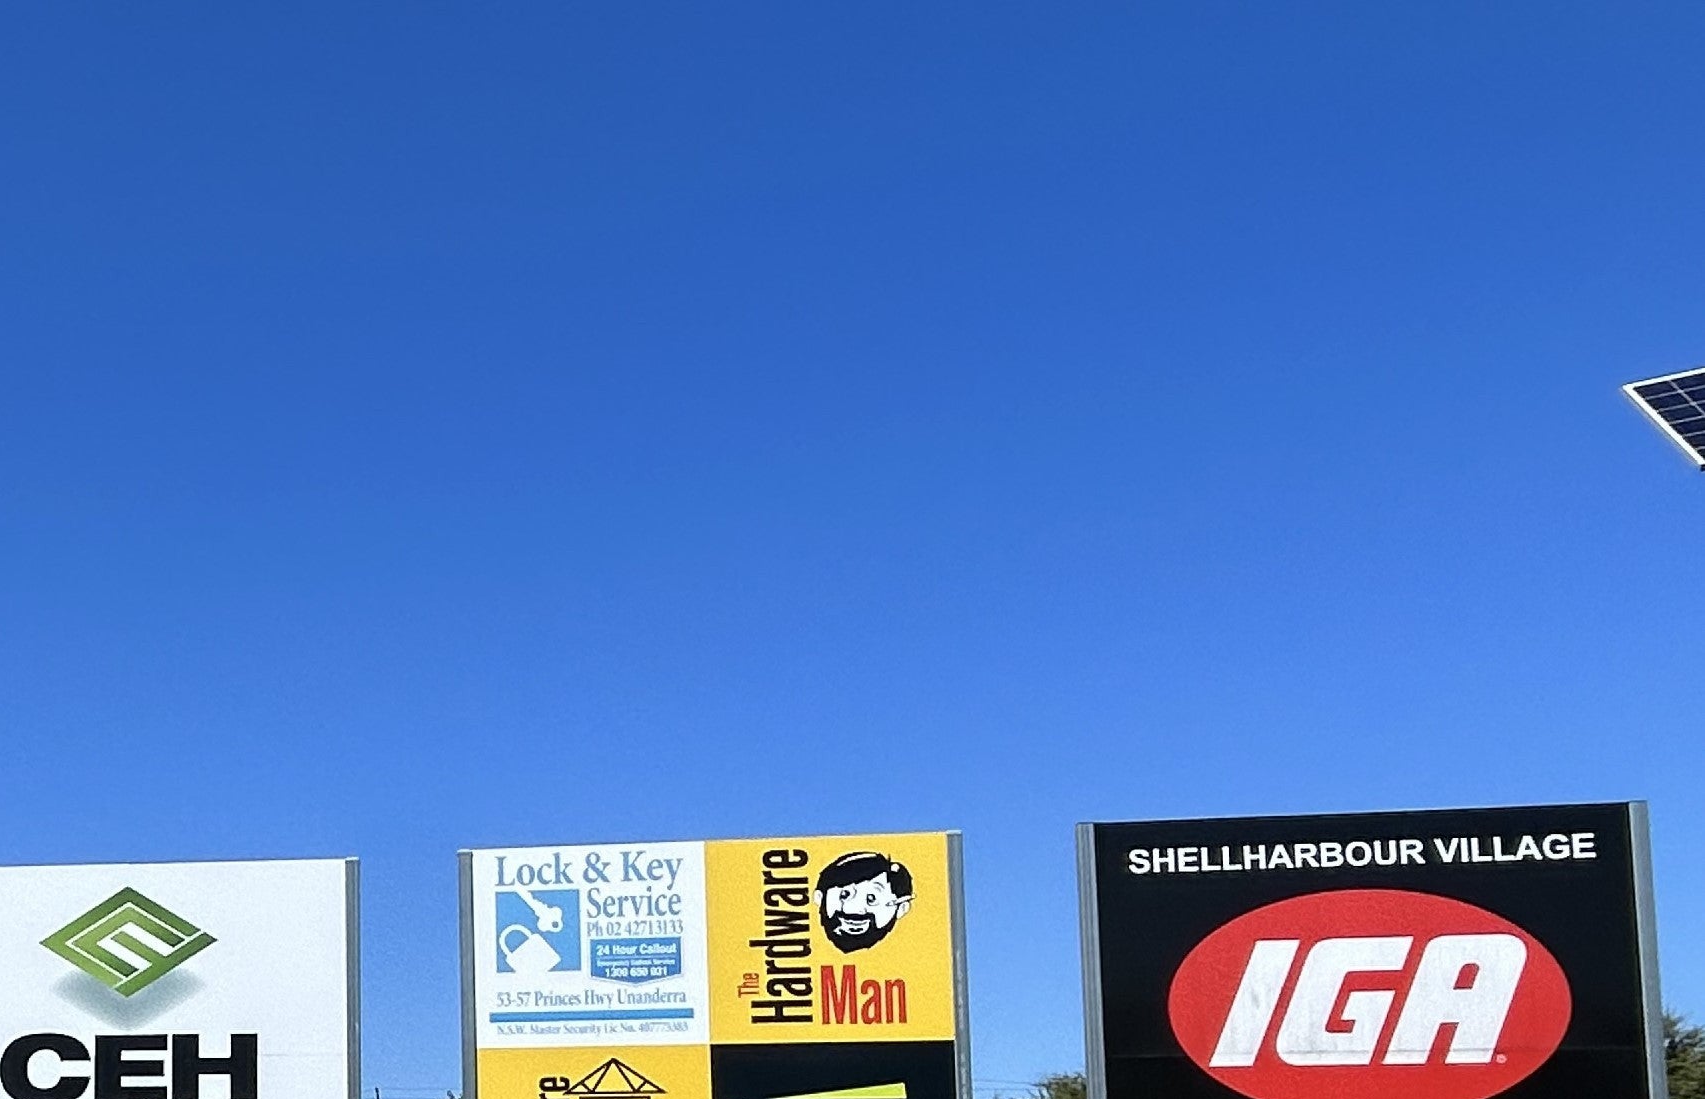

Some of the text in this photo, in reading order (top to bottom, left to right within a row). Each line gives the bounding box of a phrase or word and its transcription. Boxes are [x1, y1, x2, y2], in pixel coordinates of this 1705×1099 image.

[495, 850, 683, 890] Lock & Key
[1128, 832, 1597, 875] SHELLHARBOUR VILLAGE
[587, 886, 682, 918] Service
[587, 920, 603, 936] Ph
[606, 921, 621, 936] 02
[749, 849, 813, 1024] Hardware
[612, 944, 637, 955] Hour
[534, 990, 580, 1006] Princes
[584, 989, 614, 1008] Hwy
[617, 987, 686, 1005] Unanderra
[737, 972, 759, 998] The
[820, 964, 907, 1025] Man
[1208, 932, 1527, 1068] IGA
